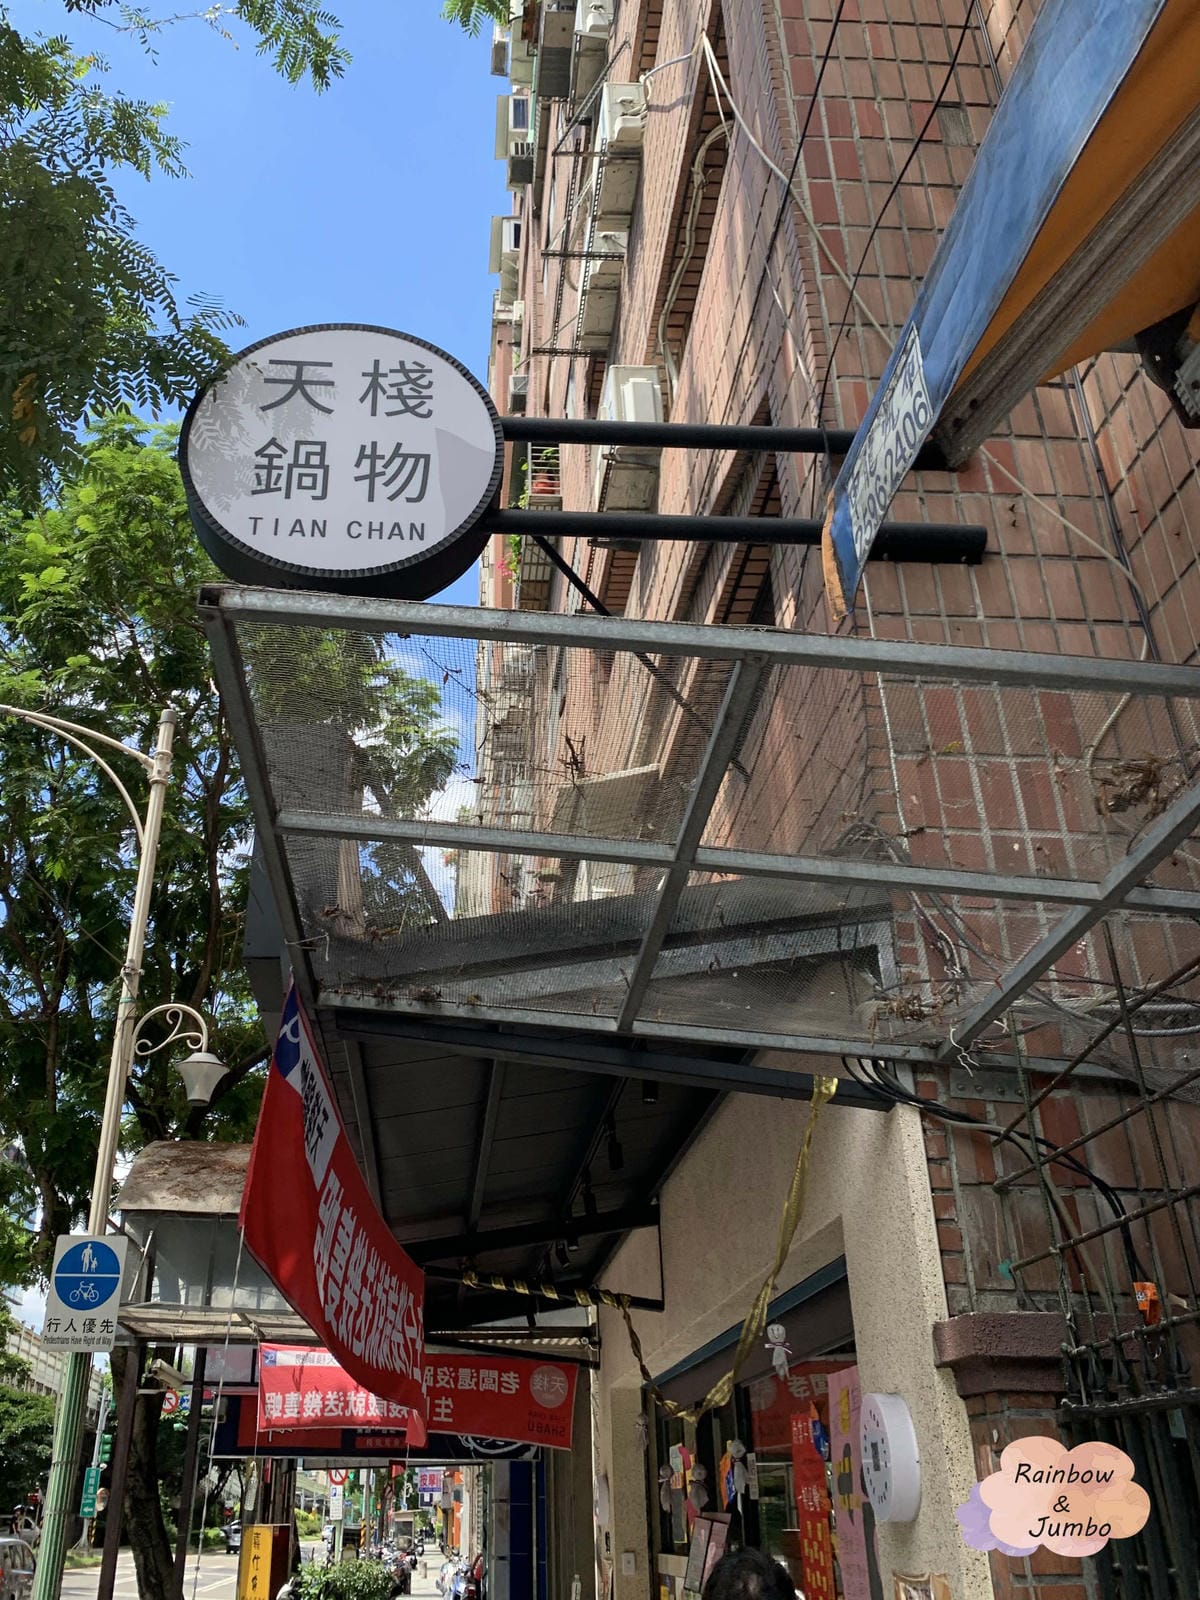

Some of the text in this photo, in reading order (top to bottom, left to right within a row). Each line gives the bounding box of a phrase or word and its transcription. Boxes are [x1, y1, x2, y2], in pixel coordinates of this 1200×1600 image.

[259, 358, 434, 419] 天棧
[251, 436, 431, 504] 鍋物
[248, 516, 426, 541] TIAN CHAN
[46, 1317, 114, 1334] 行人優先
